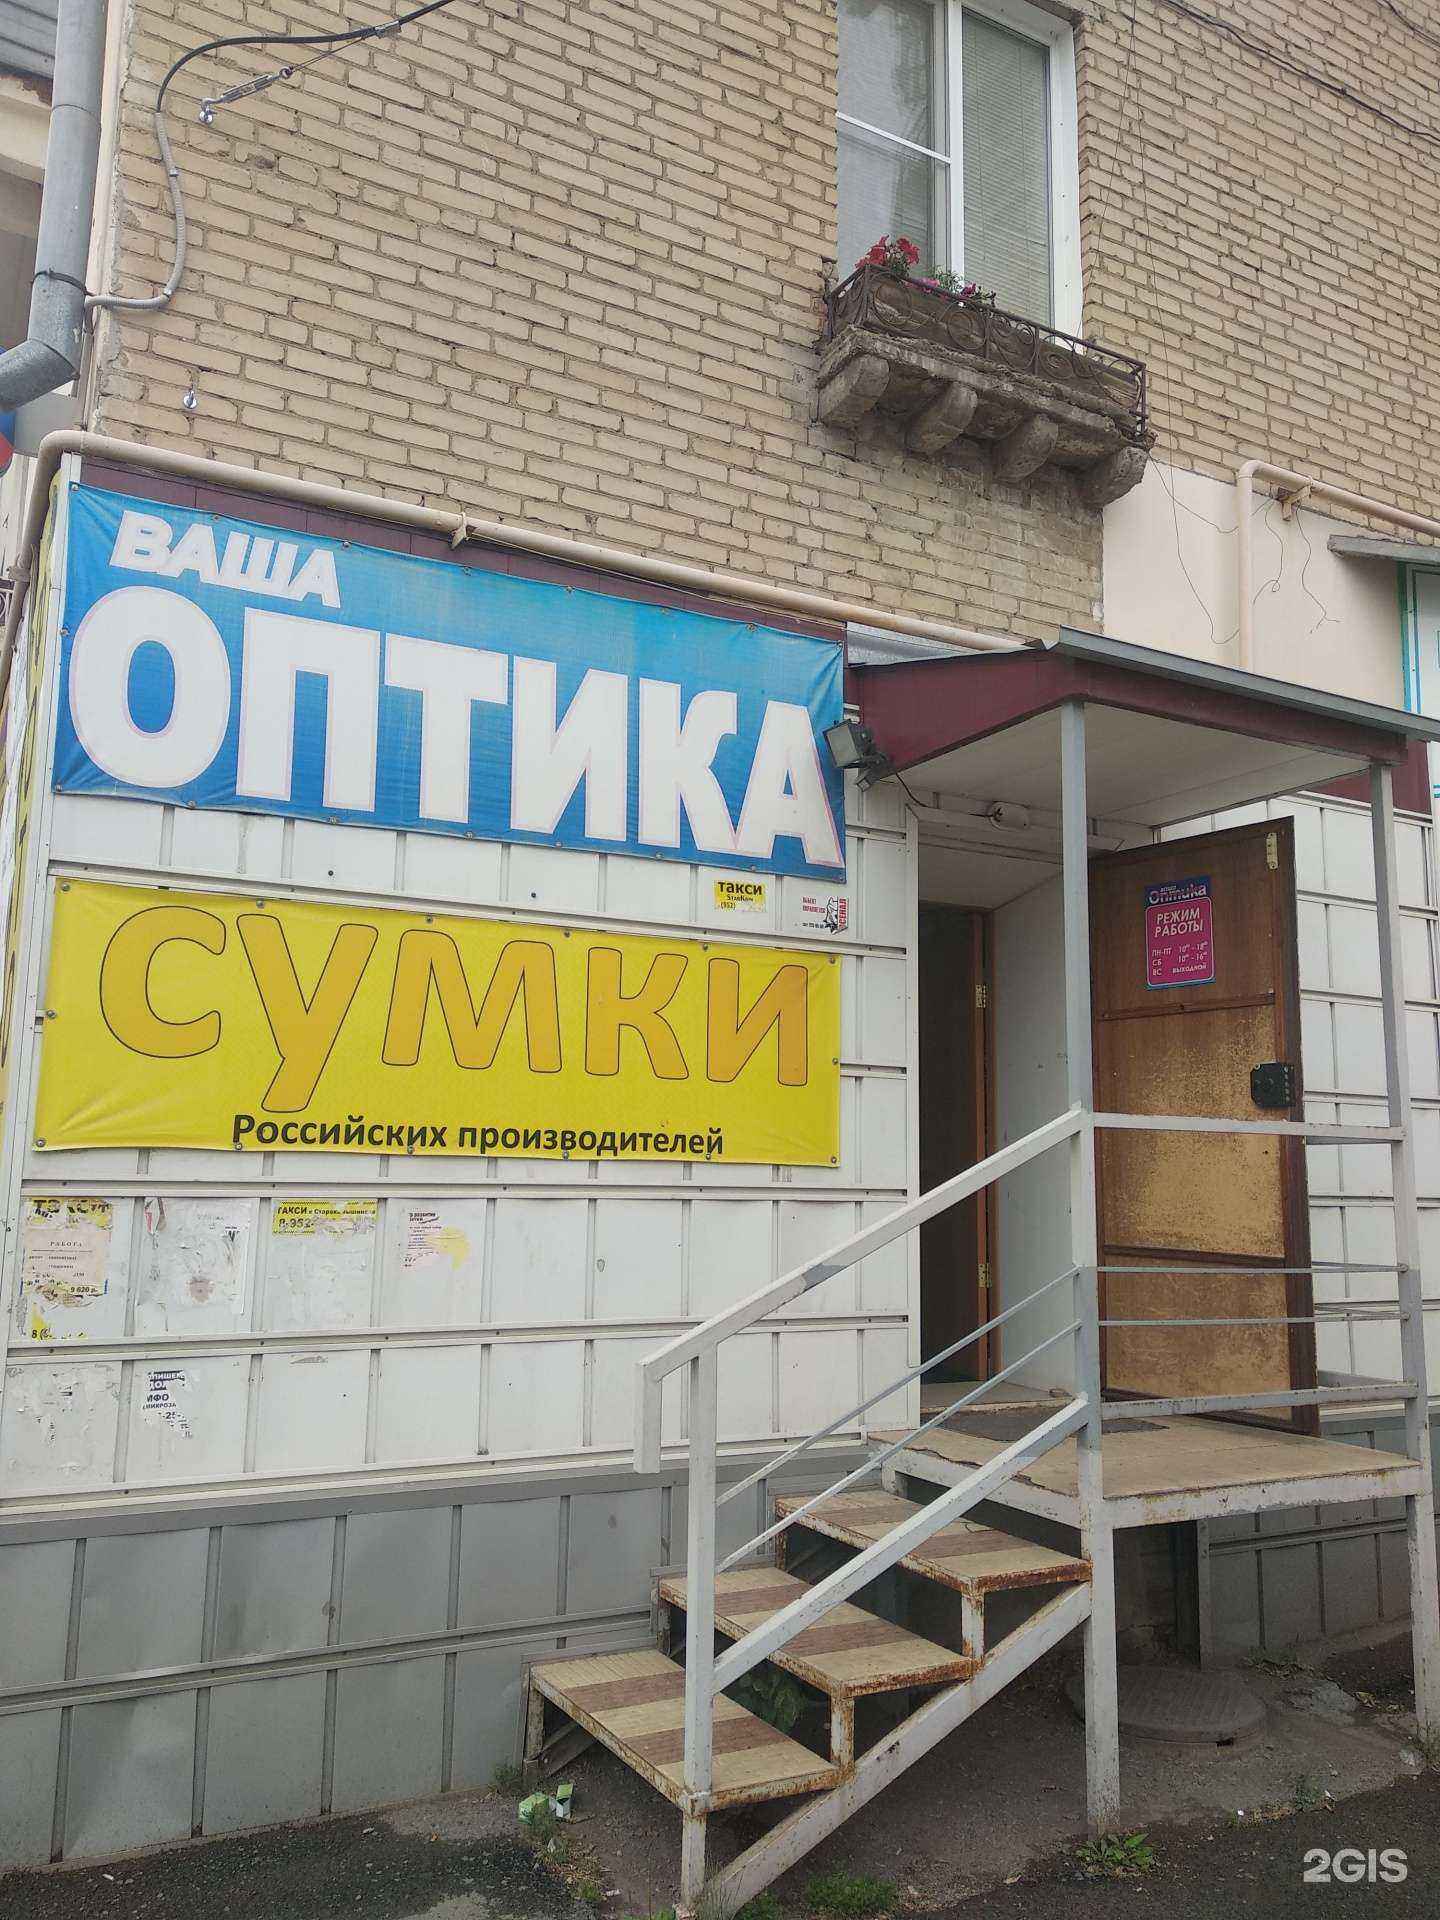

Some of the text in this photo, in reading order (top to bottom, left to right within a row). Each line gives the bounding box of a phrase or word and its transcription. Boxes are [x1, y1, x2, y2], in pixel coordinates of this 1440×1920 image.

[110, 510, 342, 608] ВАША
[69, 585, 845, 868] ОПТИКА
[1156, 907, 1200, 925] РЕЖИМ
[1154, 919, 1203, 938] РАБОТЫ
[1152, 947, 1172, 957] ПН-ПТ
[1152, 959, 1162, 967] СБ
[233, 1114, 723, 1158] Российских производителей
